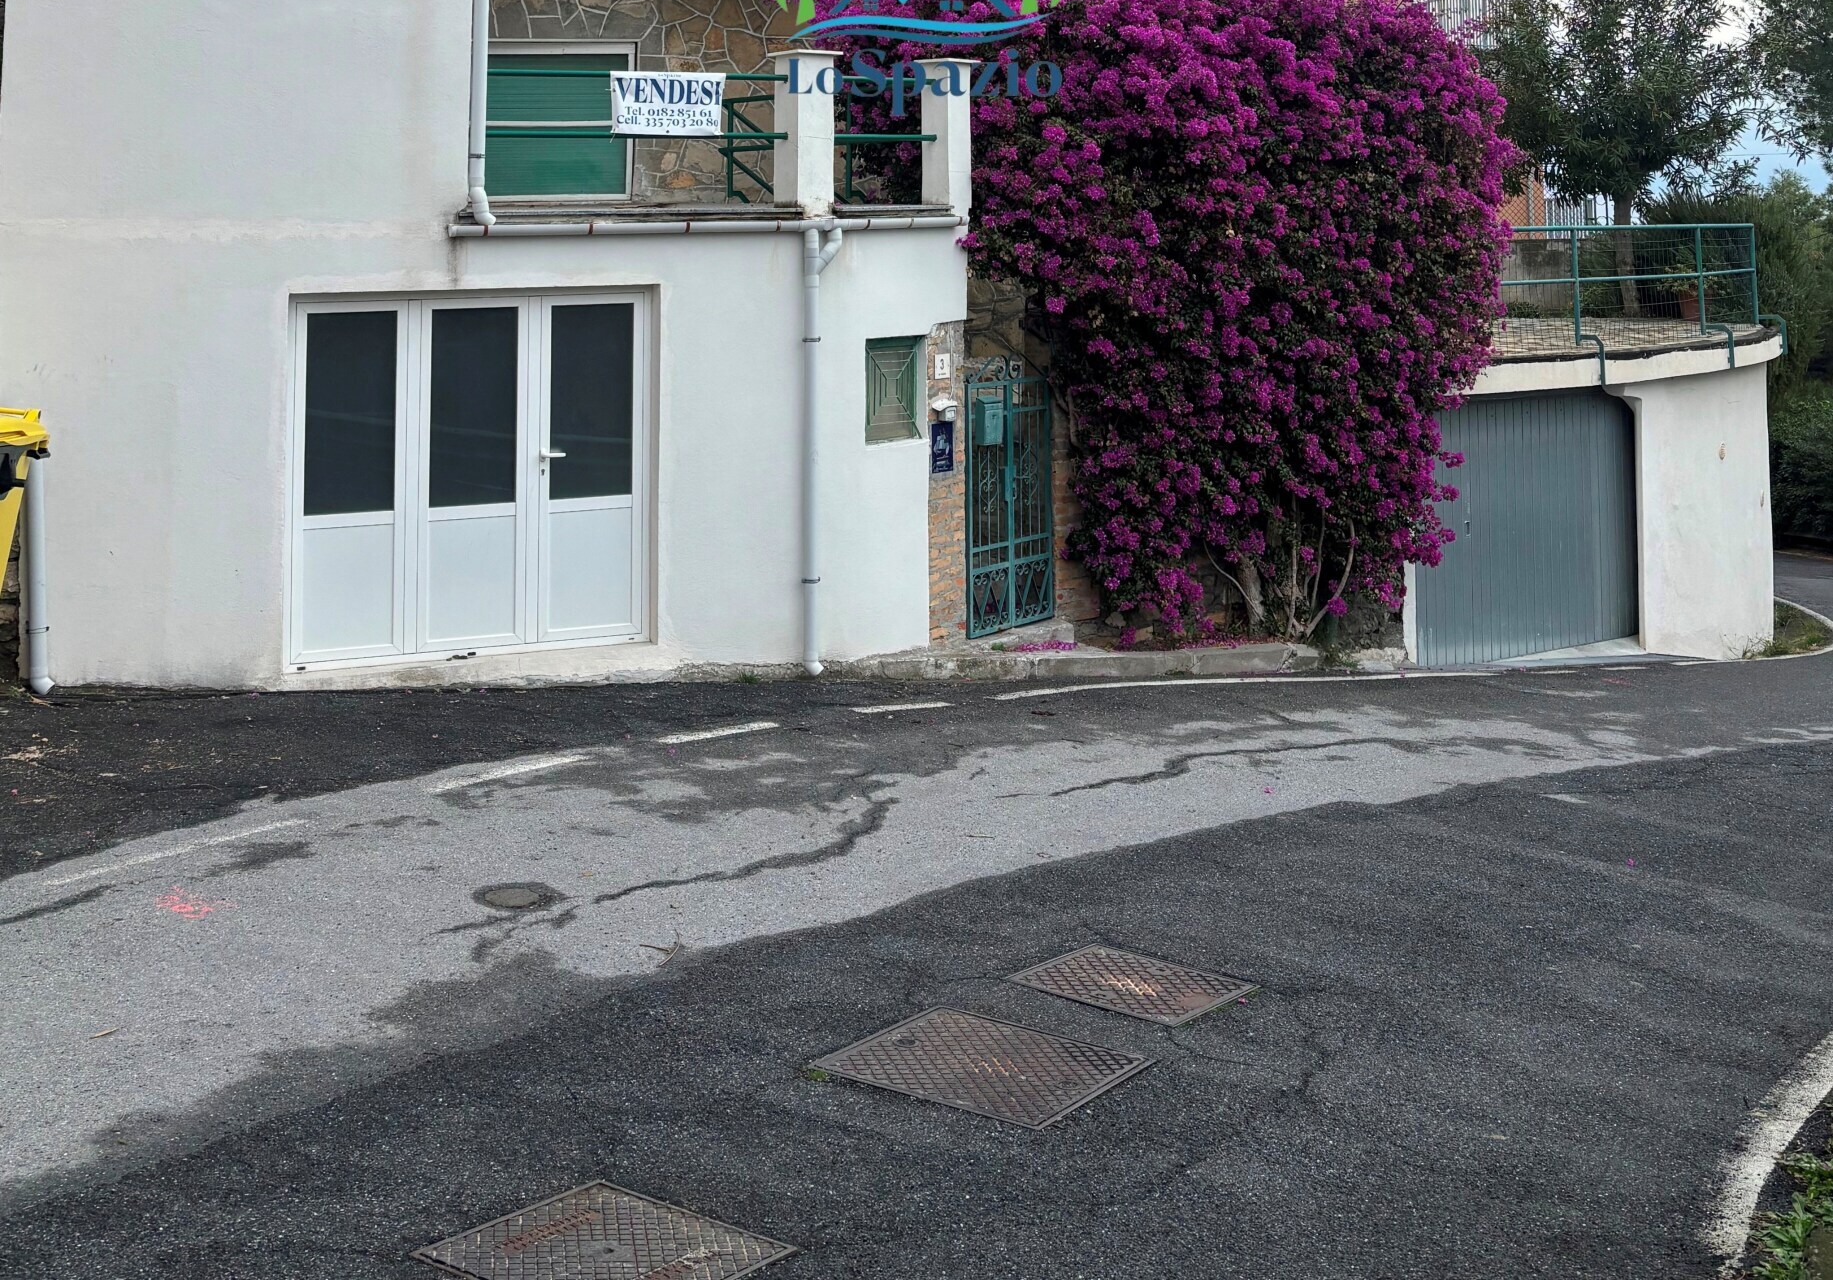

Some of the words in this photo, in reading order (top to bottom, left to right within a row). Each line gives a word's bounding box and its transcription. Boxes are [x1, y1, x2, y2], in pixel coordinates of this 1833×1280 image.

[615, 77, 721, 105] VENDESI
[624, 106, 645, 117] Tel.
[647, 107, 675, 117] 0182
[677, 108, 697, 119] 851
[699, 108, 712, 118] 61
[616, 114, 641, 125] Cell.
[645, 118, 664, 128] 335
[666, 118, 686, 128] 703
[689, 118, 704, 127] 20
[939, 358, 945, 370] 3
